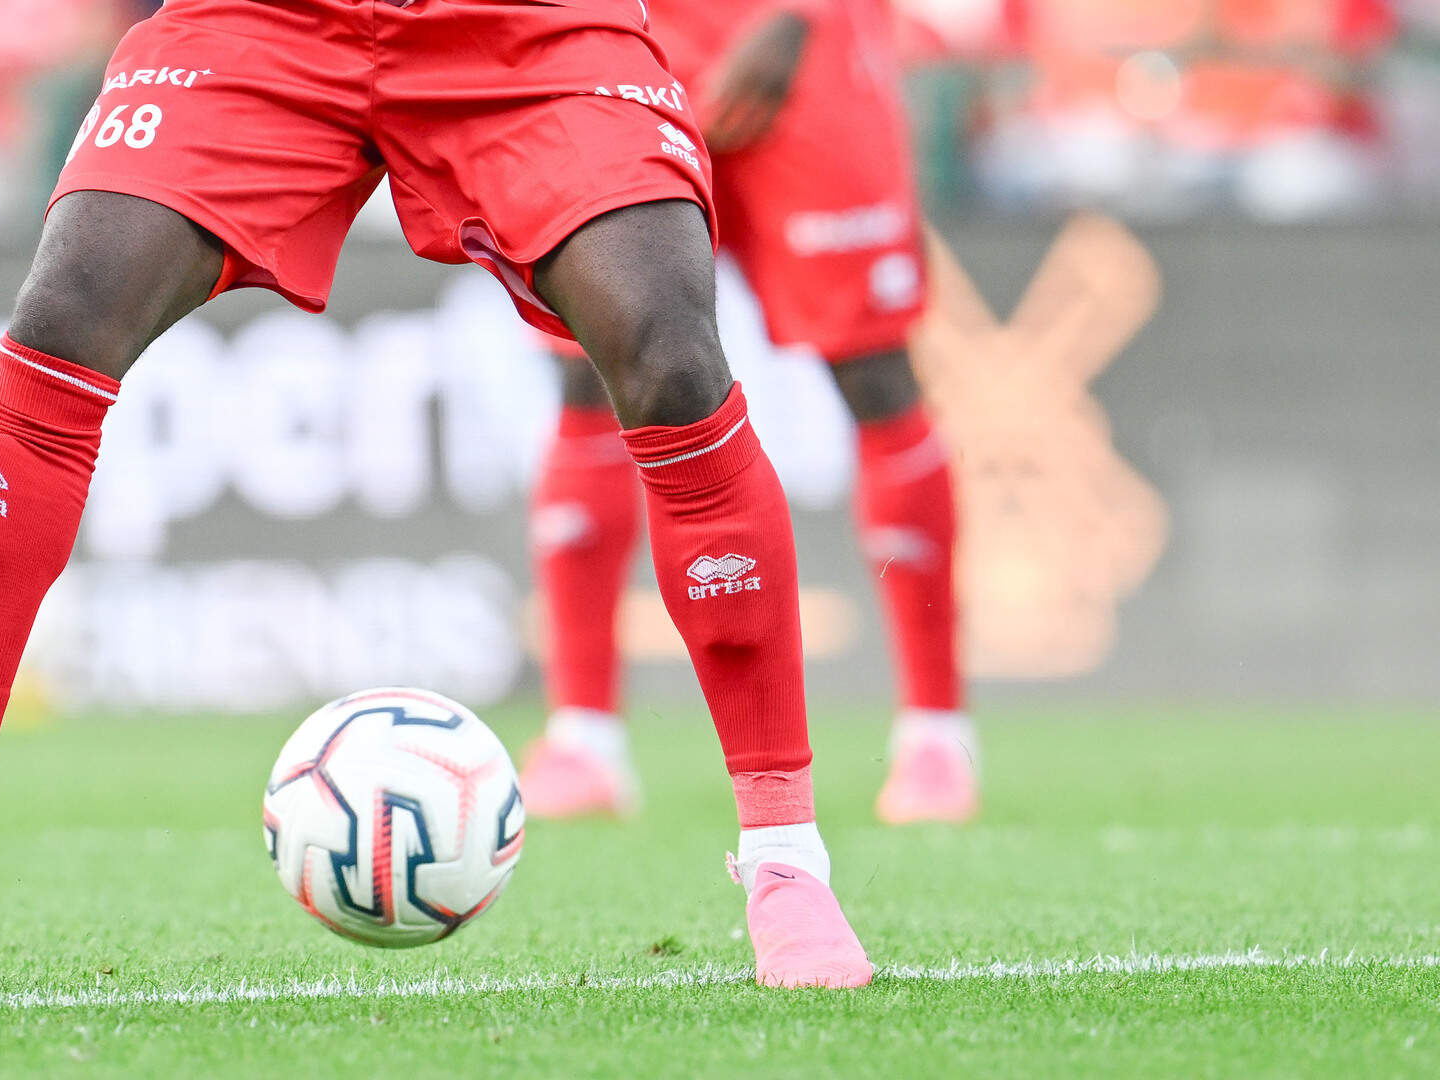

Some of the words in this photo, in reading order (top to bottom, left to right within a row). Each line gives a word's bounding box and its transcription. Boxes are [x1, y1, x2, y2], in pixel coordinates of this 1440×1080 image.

[102, 66, 198, 96] ARKI
[661, 141, 701, 172] errea
[687, 576, 761, 600] errea
